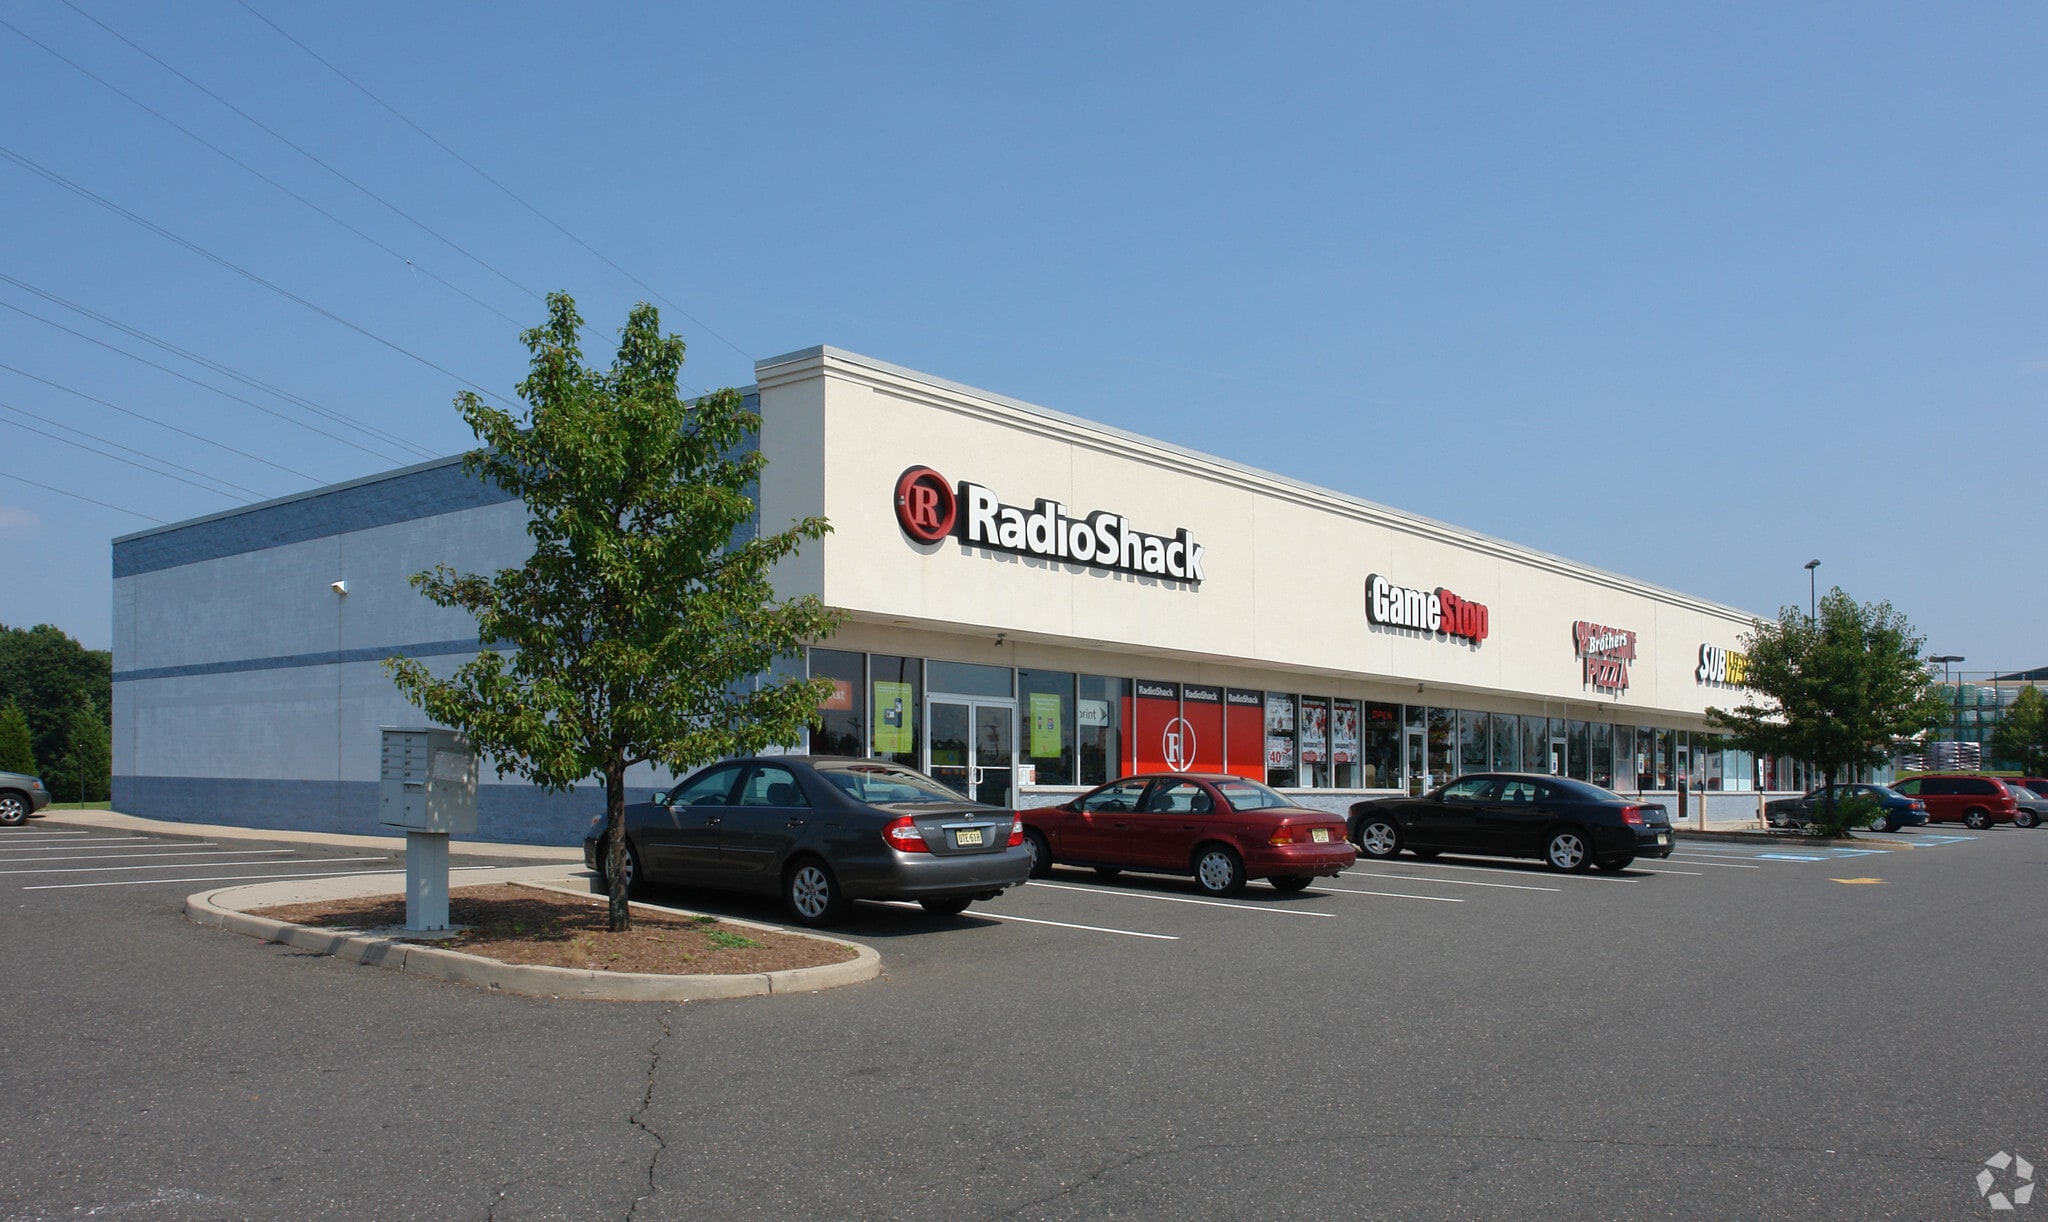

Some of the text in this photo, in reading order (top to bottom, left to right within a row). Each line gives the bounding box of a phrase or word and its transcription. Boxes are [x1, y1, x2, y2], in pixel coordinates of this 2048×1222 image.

[912, 485, 939, 528] R
[968, 484, 1205, 580] RadioShack
[1373, 576, 1488, 642] GameStop
[1589, 633, 1627, 654] Brothers
[1588, 657, 1629, 689] PIZZA
[1138, 686, 1174, 697] RadioShack
[1185, 689, 1218, 701] RadioShack
[1228, 694, 1259, 704] RadioShack
[1371, 710, 1393, 720] OPEN
